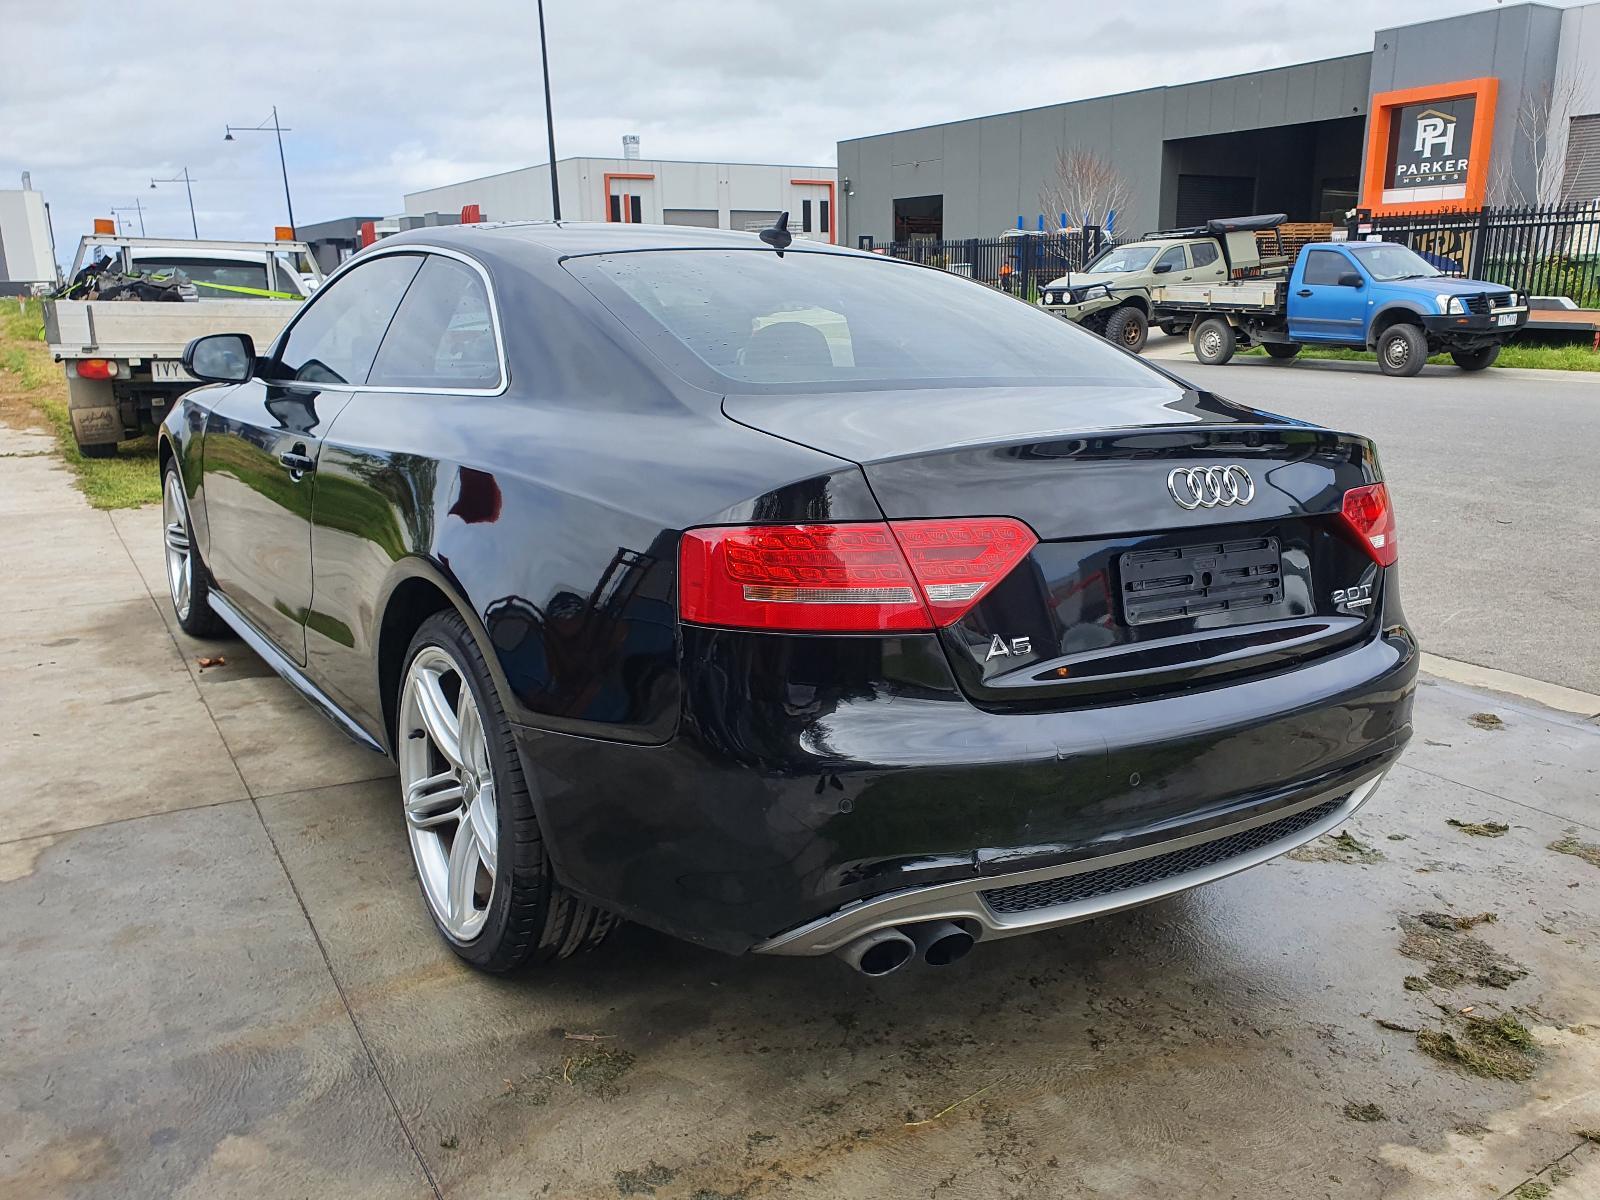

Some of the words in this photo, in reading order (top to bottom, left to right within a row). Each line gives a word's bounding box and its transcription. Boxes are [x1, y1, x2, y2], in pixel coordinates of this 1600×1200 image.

[1397, 159, 1468, 176] PARKER
[1403, 174, 1459, 184] HOMES
[985, 633, 1032, 662] A5
